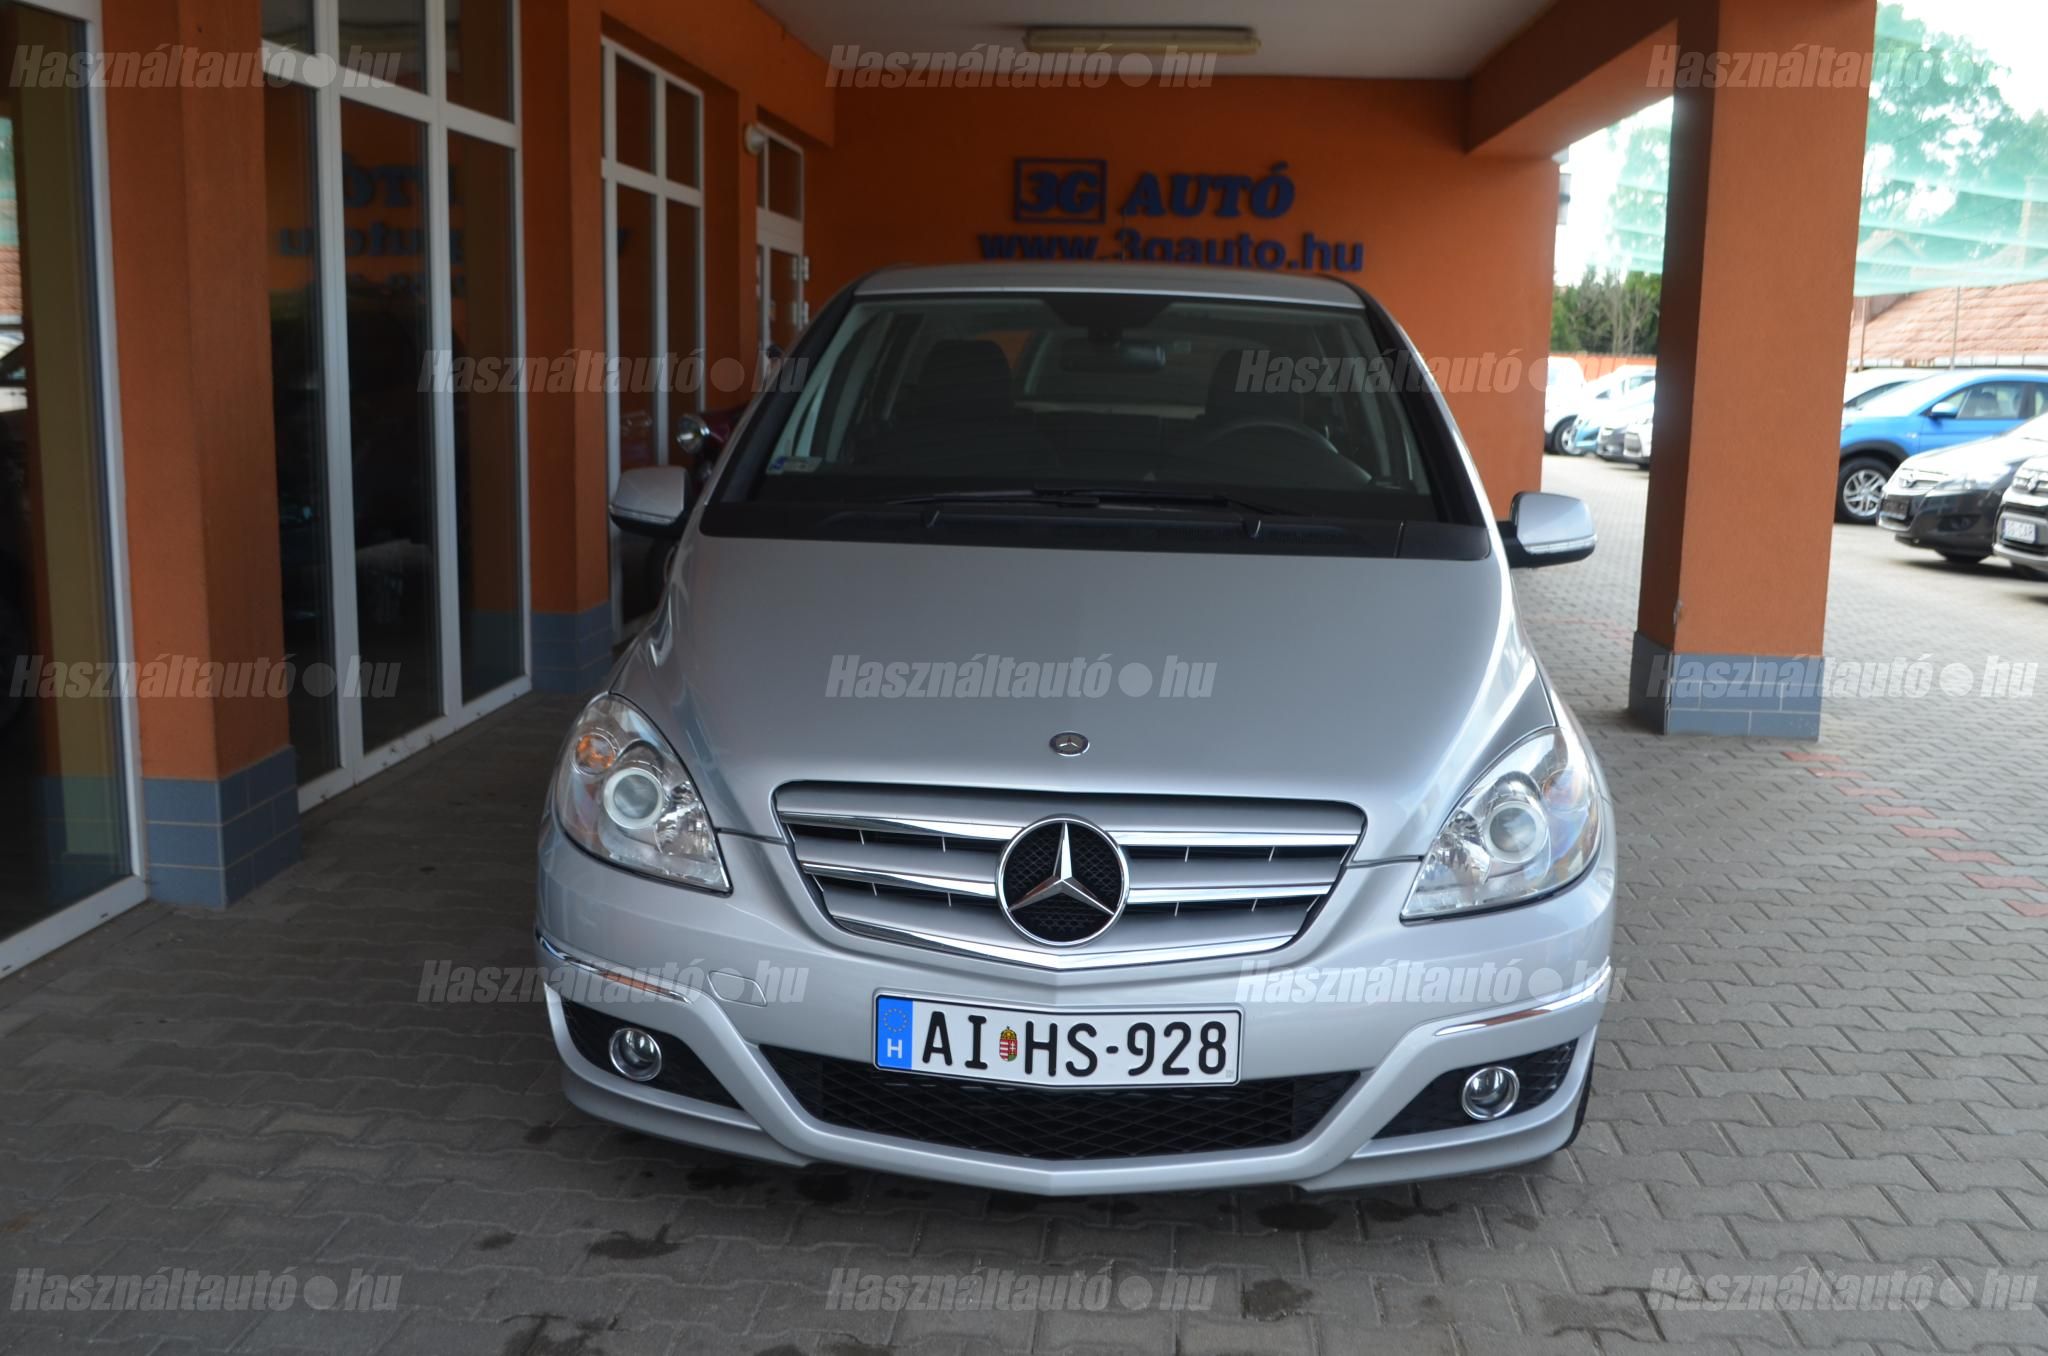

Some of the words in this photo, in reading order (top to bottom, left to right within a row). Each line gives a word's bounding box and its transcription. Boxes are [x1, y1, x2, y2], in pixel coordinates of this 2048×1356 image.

[1023, 170, 1099, 214] 3G
[1119, 161, 1296, 219] AUTÓ
[886, 1038, 903, 1059] H
